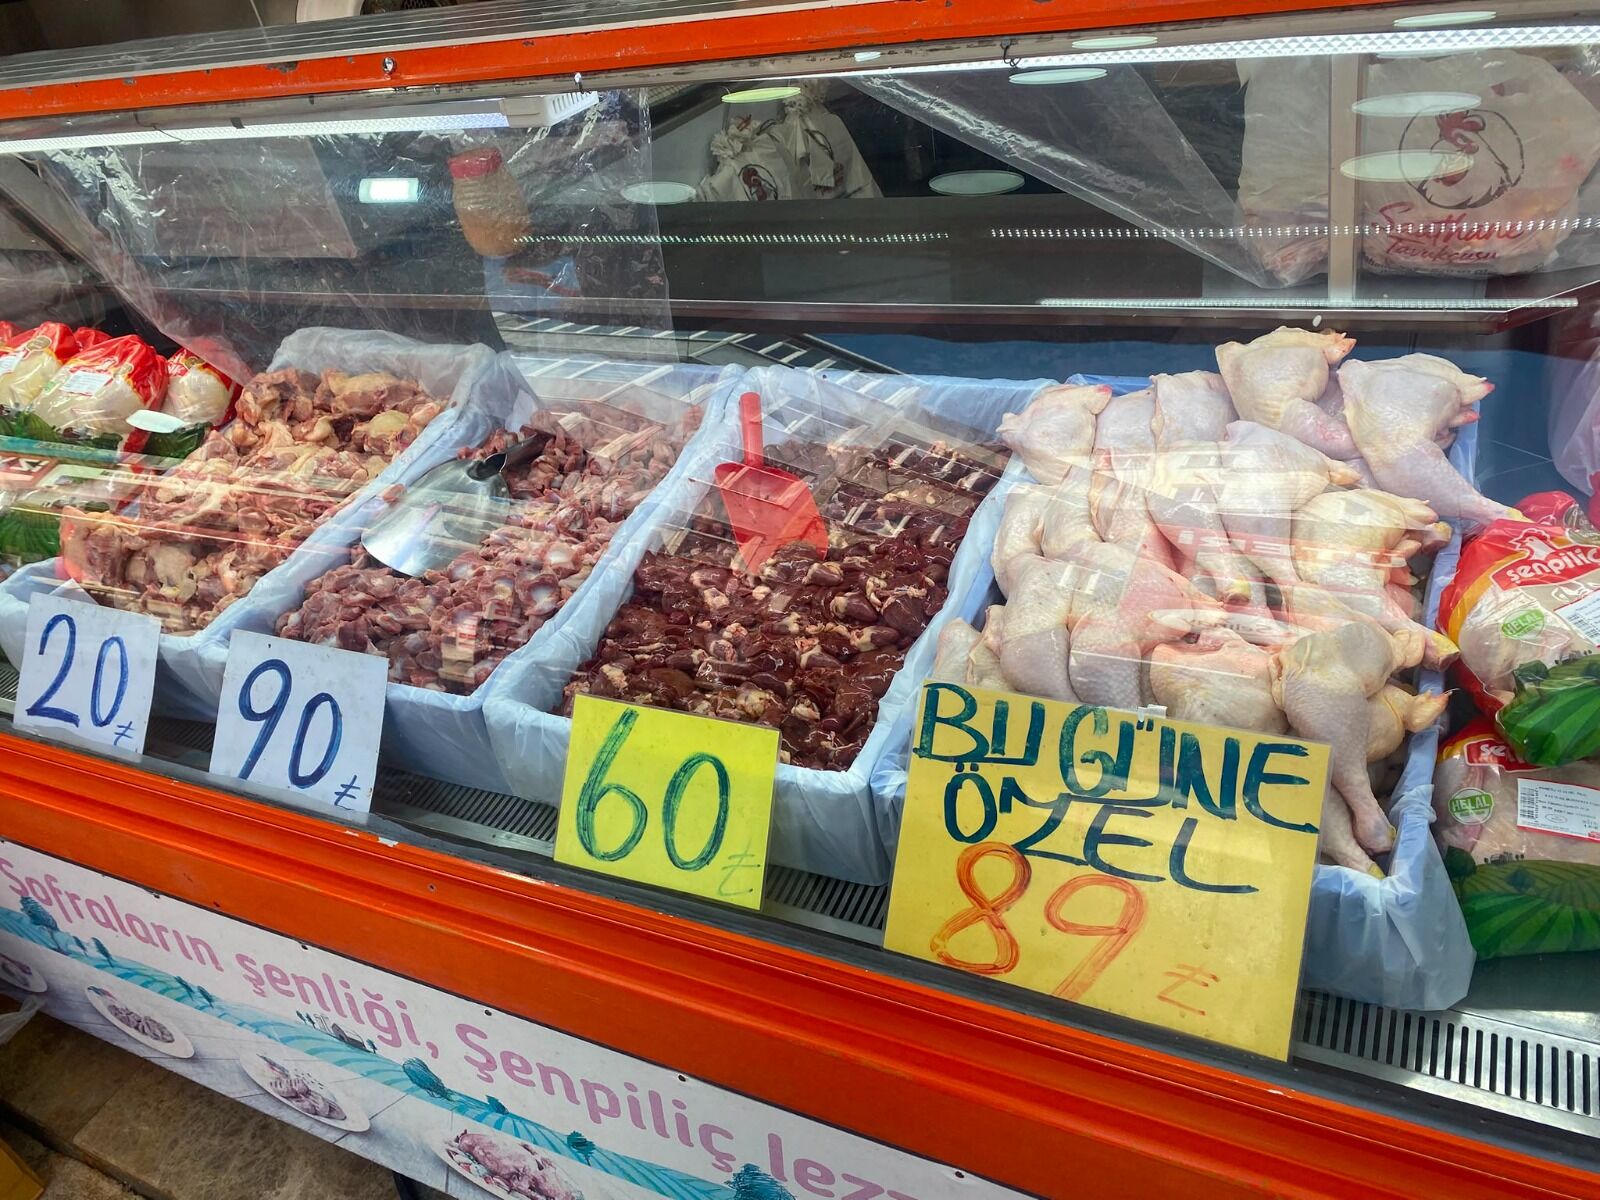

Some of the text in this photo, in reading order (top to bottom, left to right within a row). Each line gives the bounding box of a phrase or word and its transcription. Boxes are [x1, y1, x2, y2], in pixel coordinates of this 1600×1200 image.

[26, 613, 130, 728] 20
[1504, 611, 1543, 636] HELAL
[238, 658, 343, 790] 90
[576, 707, 731, 873] 60
[943, 761, 1260, 894] ÖZEL
[1451, 795, 1491, 813] HELAL
[929, 841, 1150, 1001] 89
[0, 857, 224, 972] Sofraların
[235, 953, 440, 1060] şenliği,
[455, 1023, 738, 1173] Şenpiliç
